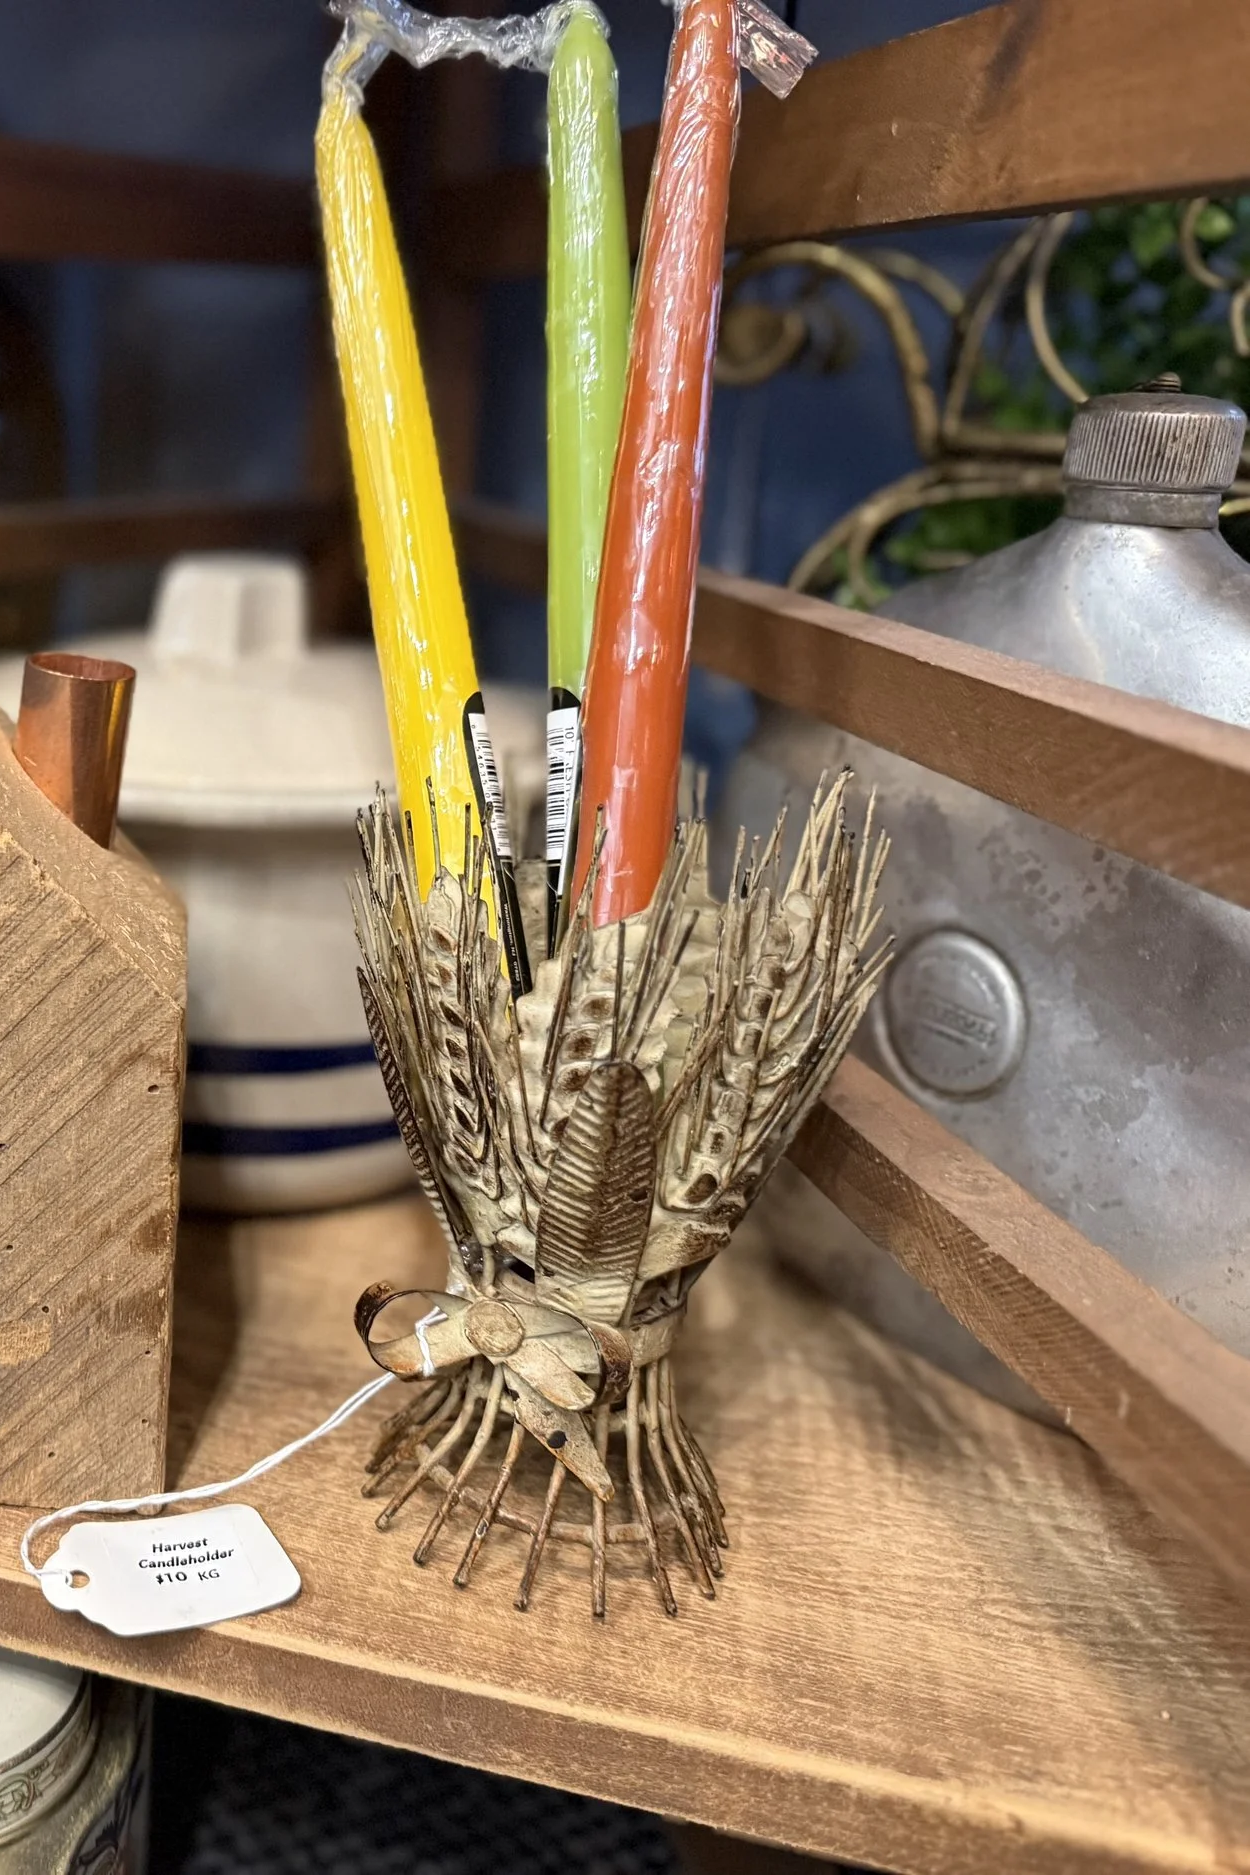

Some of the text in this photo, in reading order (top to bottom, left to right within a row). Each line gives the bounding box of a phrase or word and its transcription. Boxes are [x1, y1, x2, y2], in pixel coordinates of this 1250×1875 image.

[151, 1537, 209, 1554] Harvest
[138, 1548, 235, 1570] Candleholder
[155, 1568, 220, 1586] $10 KG
